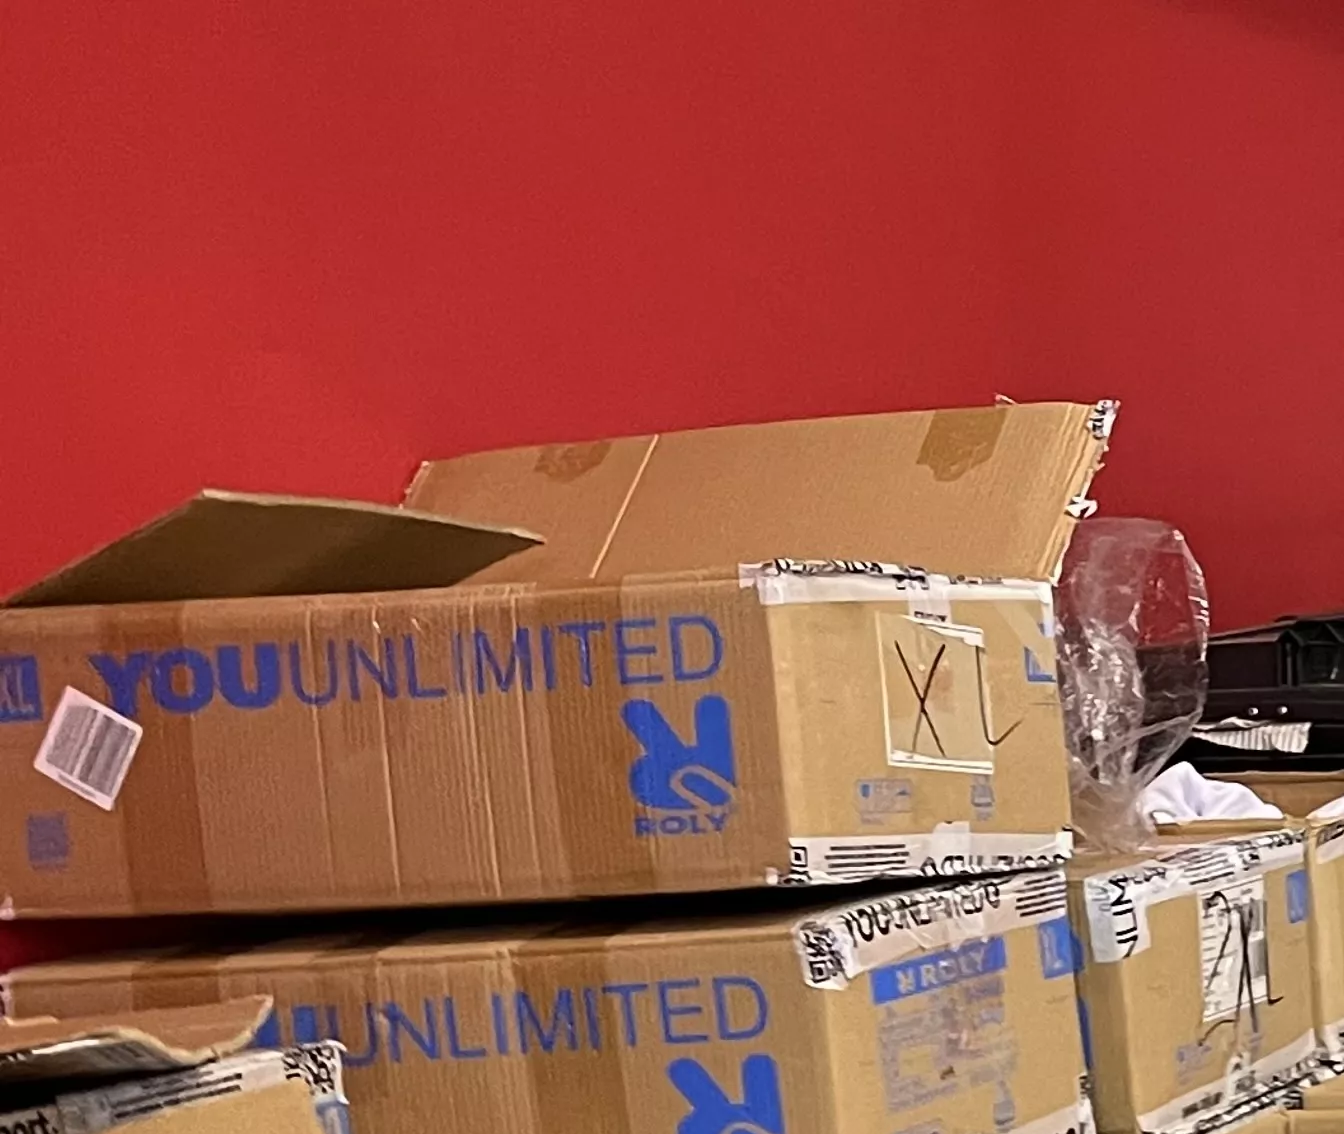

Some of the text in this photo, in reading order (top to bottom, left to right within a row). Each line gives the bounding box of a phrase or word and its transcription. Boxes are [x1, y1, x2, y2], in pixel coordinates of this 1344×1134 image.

[635, 811, 728, 839] ROLY
[919, 947, 985, 988] ROLY
[256, 976, 769, 1067] UNLIMITED
